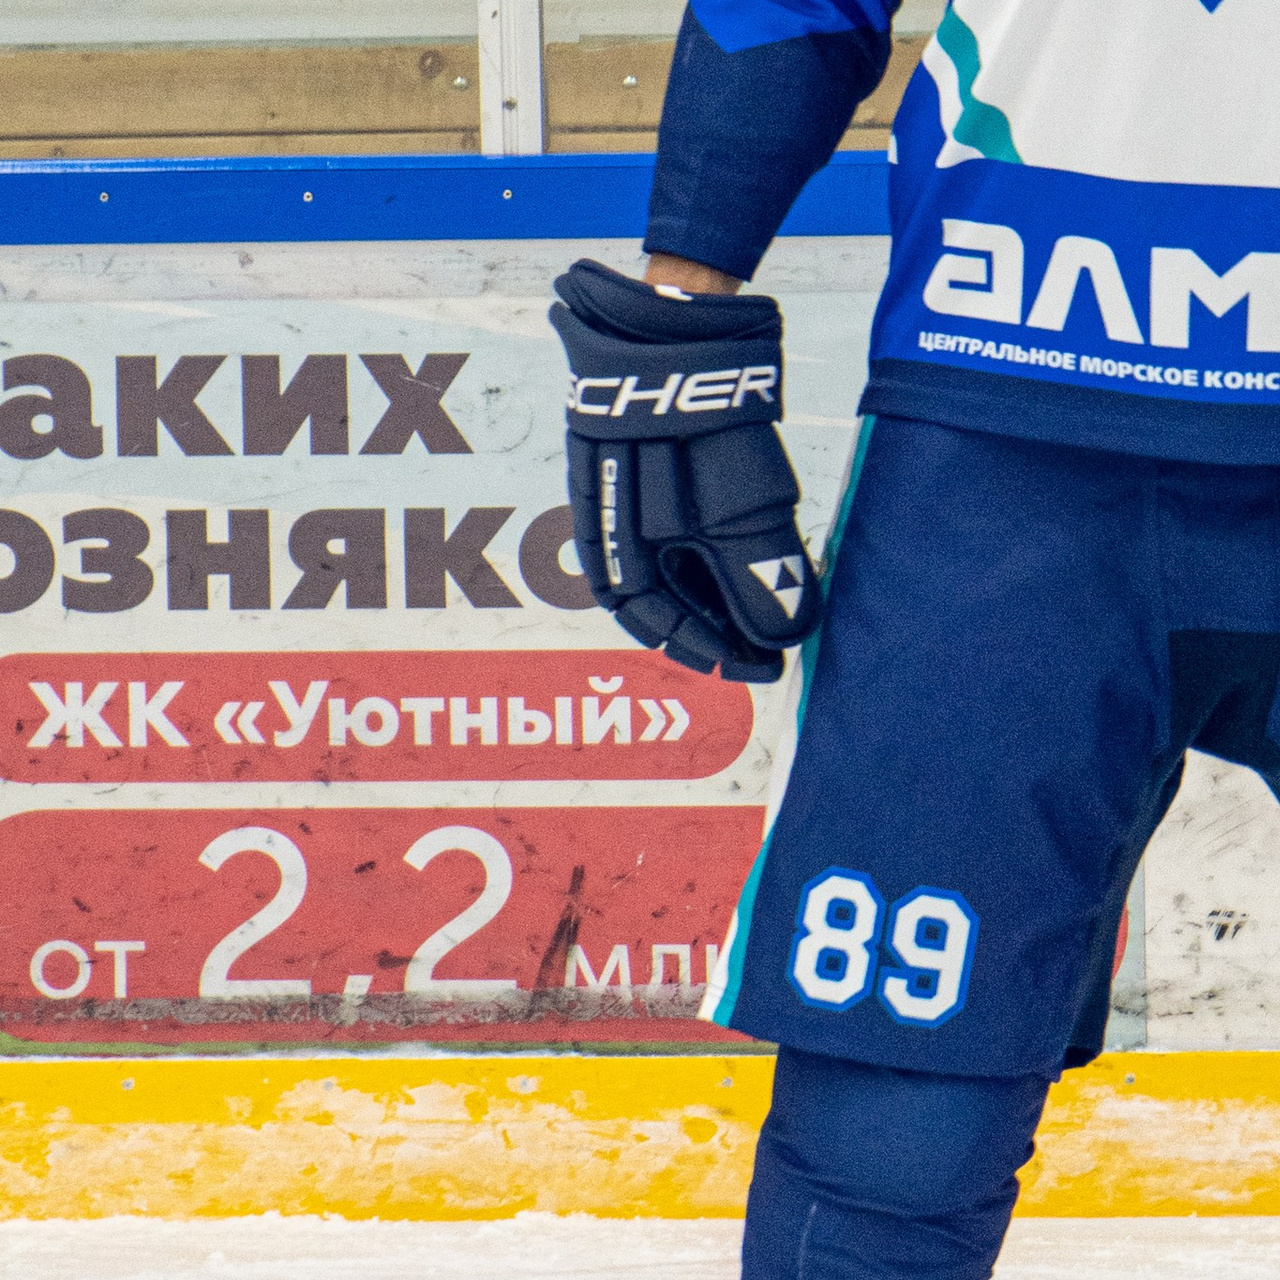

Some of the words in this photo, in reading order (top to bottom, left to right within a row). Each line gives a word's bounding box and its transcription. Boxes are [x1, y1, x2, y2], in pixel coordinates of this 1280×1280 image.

[567, 365, 778, 417] CHER
[917, 330, 1077, 371] ЦЕНТРАЛЬНОЕ
[1079, 354, 1199, 388] МОРСКОЕ
[26, 681, 191, 748] ЖК
[213, 676, 691, 748] «Уютный»
[198, 825, 518, 1023] 2,2
[789, 868, 978, 1027] 89
